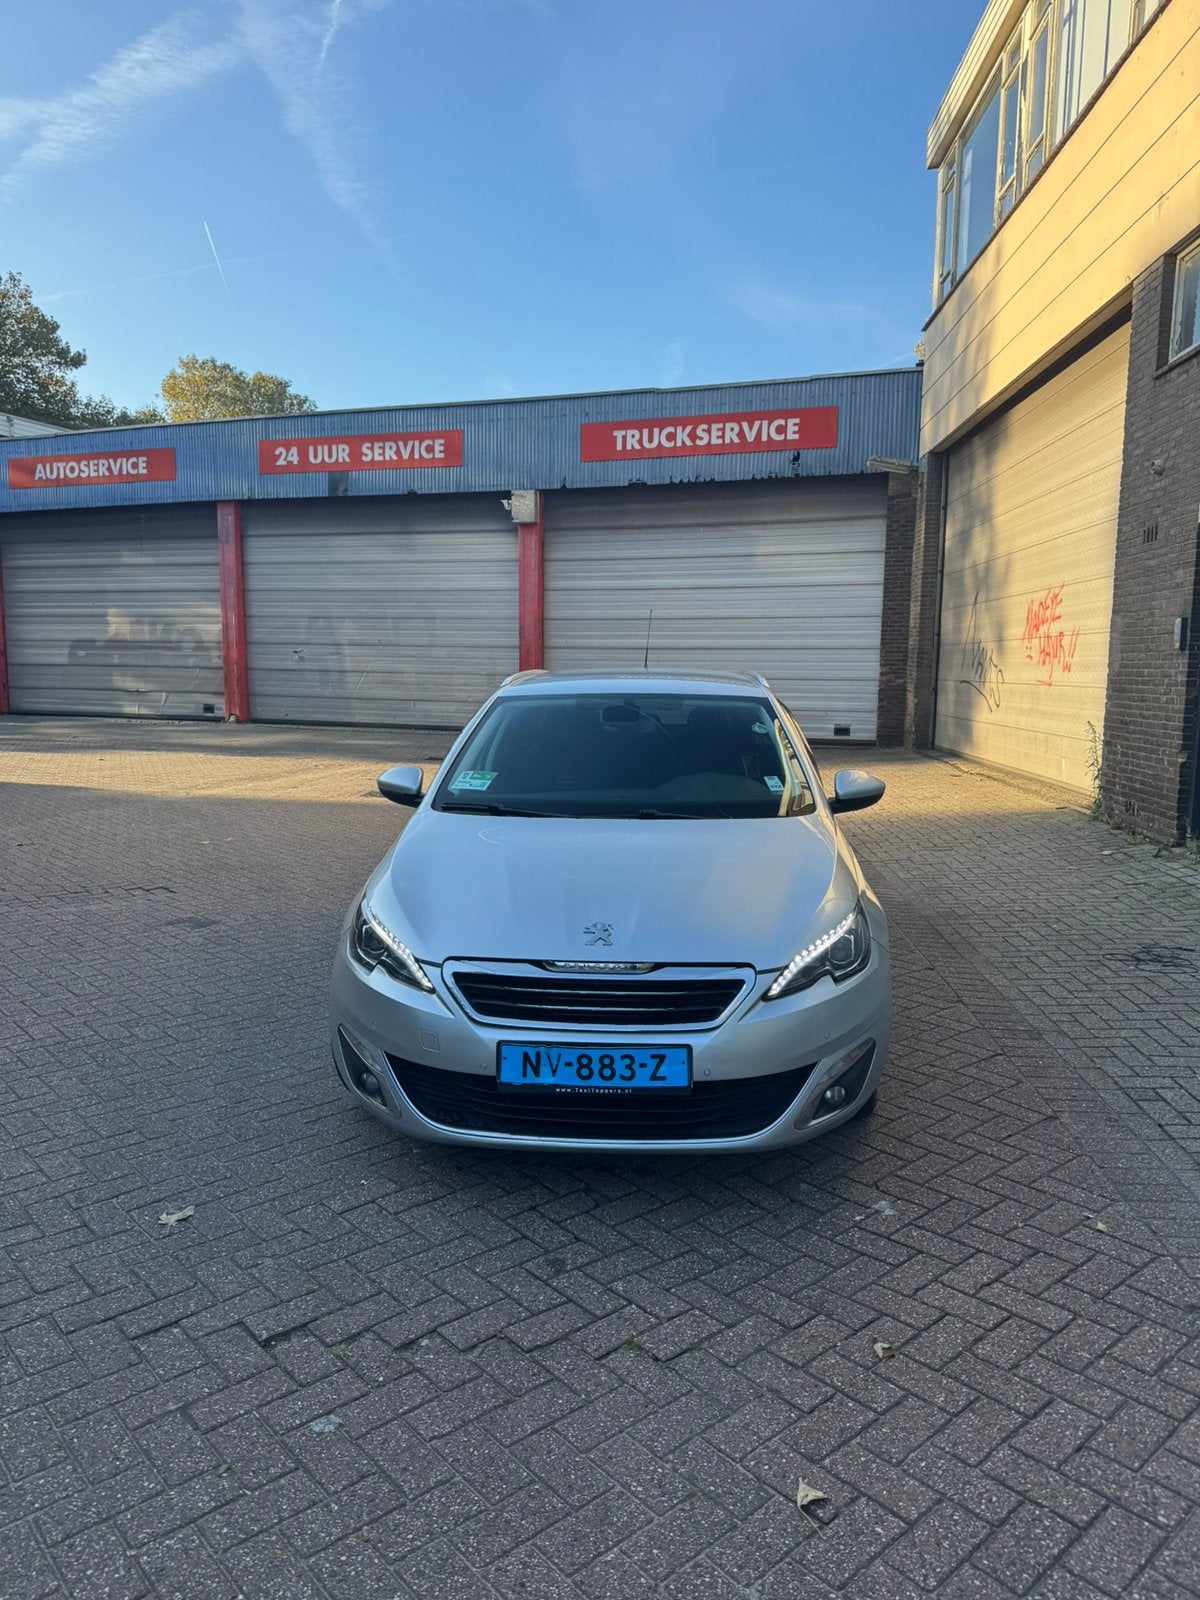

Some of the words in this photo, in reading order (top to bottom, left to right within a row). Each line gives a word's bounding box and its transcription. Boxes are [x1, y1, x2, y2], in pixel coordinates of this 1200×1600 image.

[612, 417, 801, 451] TRUCKSERVICE
[274, 448, 300, 467] 24
[308, 443, 351, 464] UUR
[361, 438, 446, 463] SERVICE
[33, 456, 148, 481] AUTOSERVICE
[521, 1051, 667, 1082] NV-883-Z
